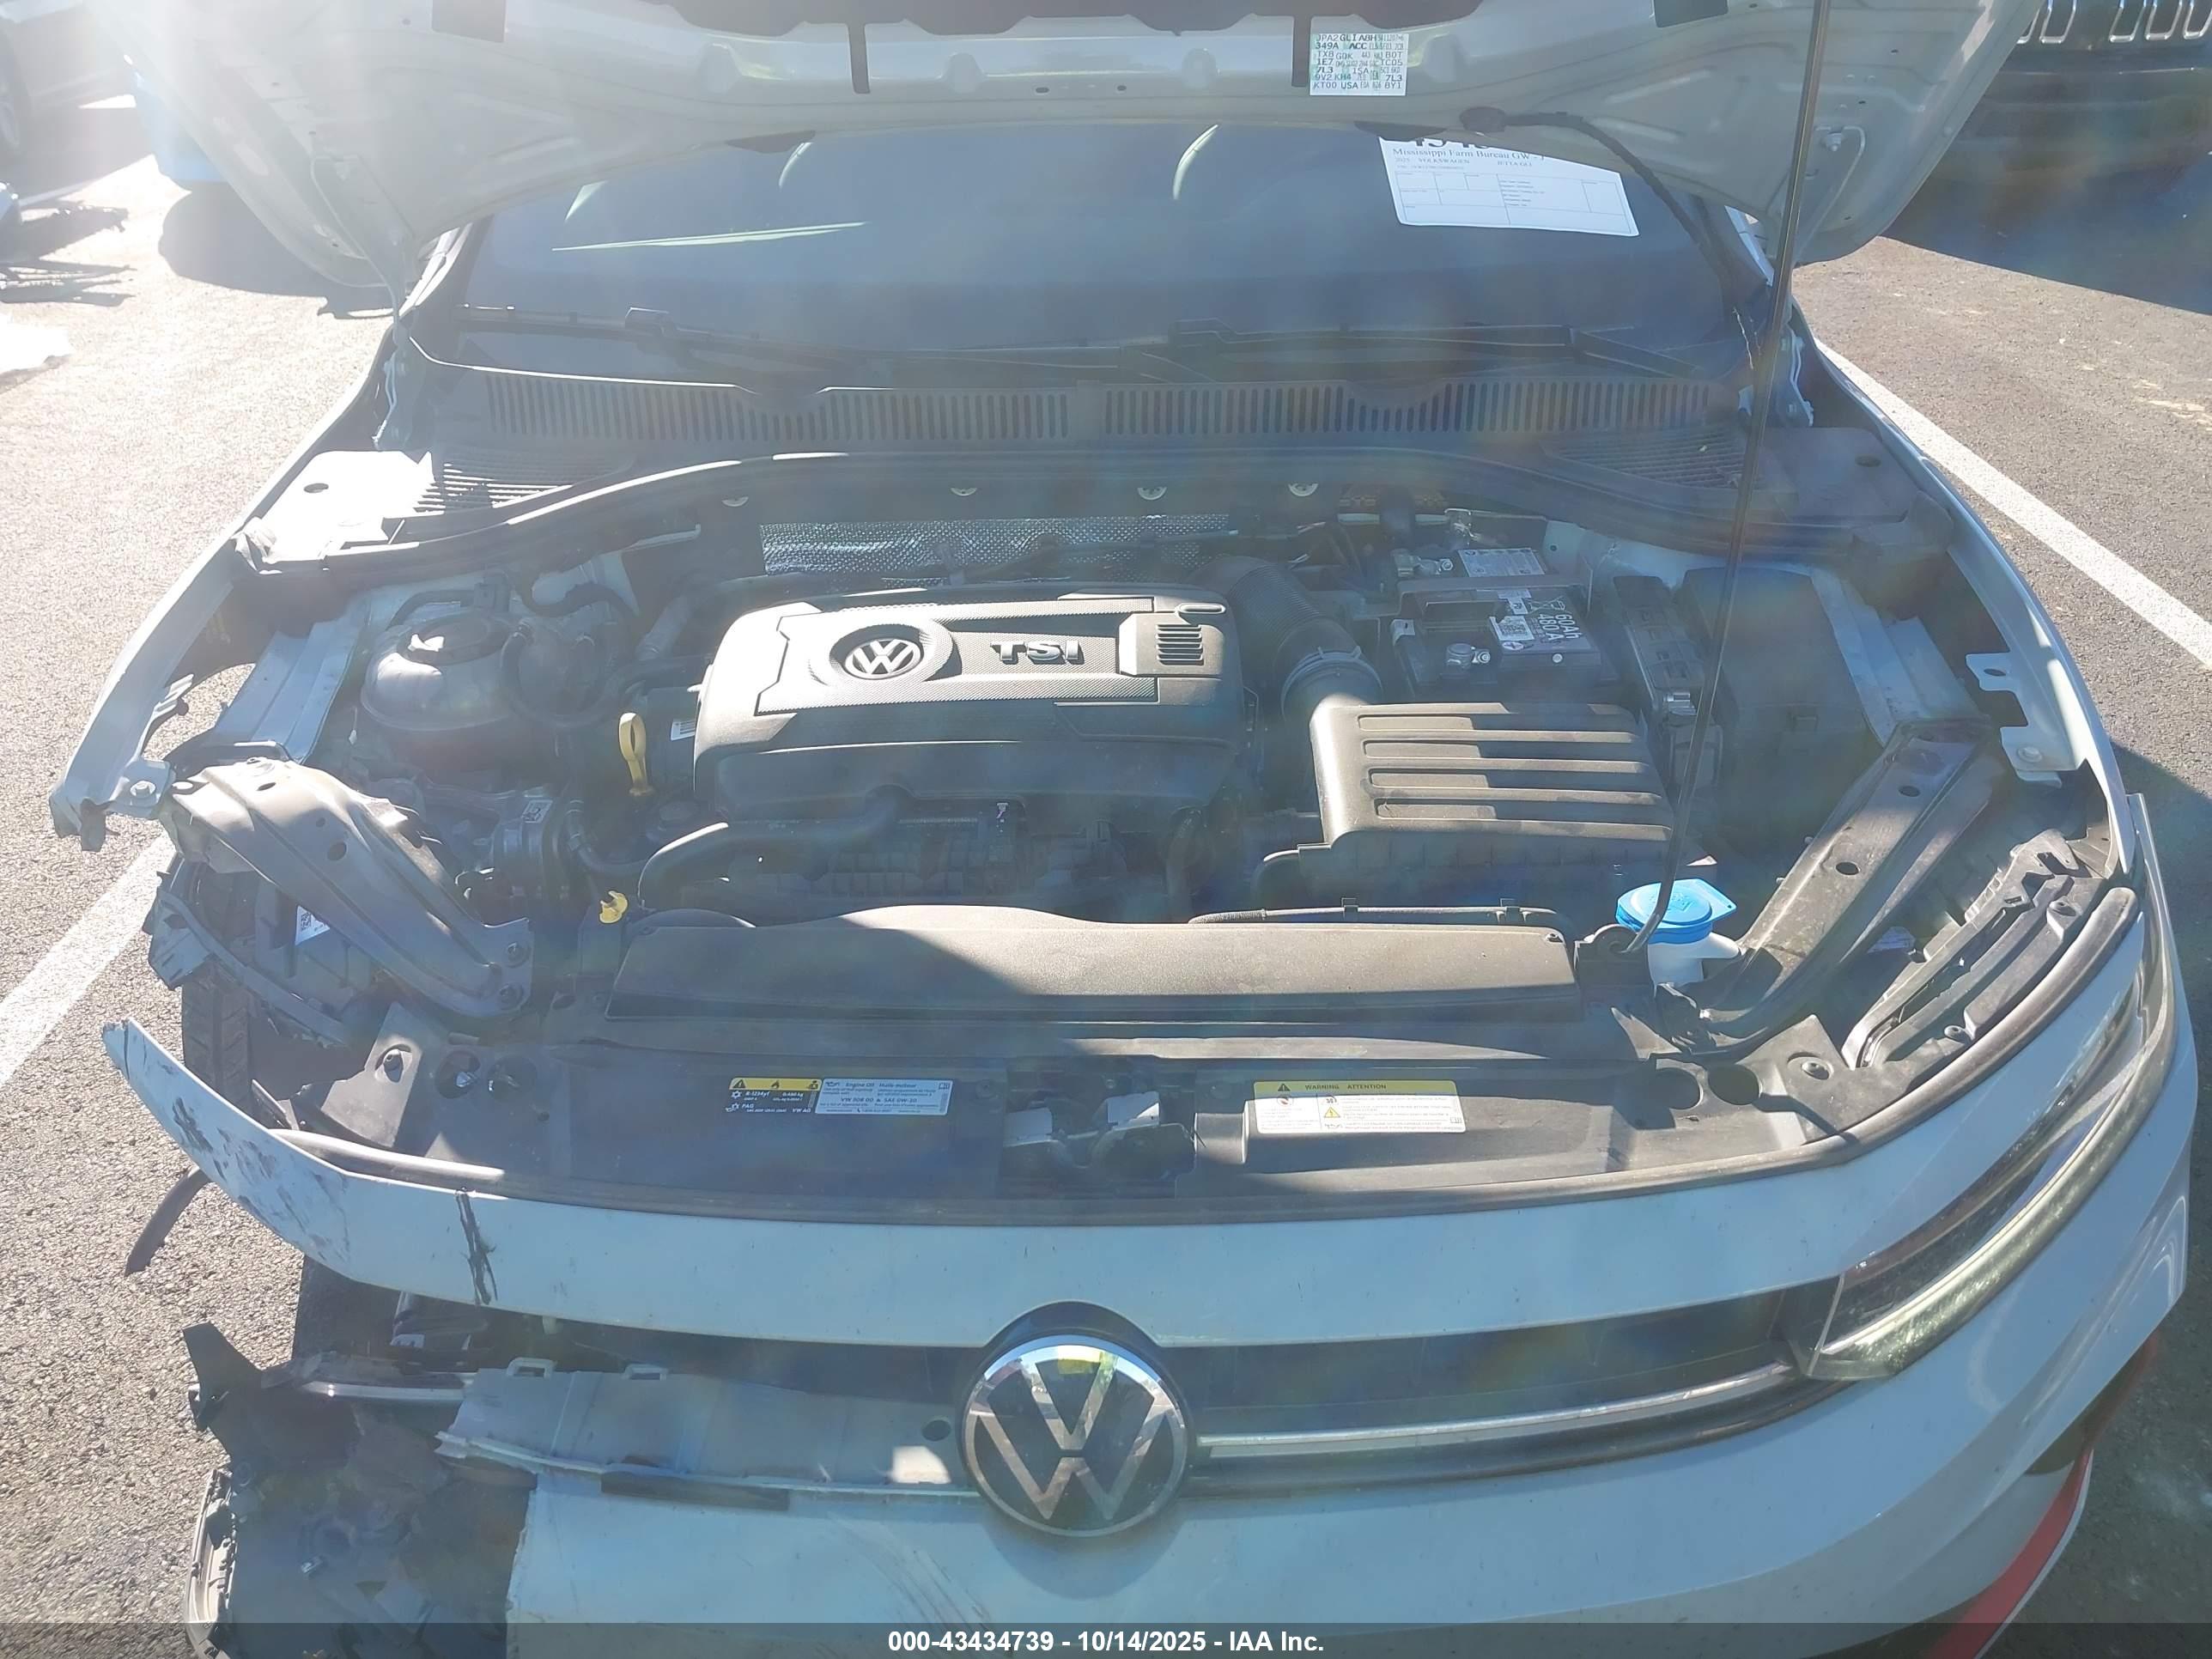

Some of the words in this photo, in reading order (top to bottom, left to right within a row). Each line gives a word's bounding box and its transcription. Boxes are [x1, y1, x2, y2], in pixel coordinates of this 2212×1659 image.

[1393, 148, 1446, 157] Mississippi
[1476, 150, 1510, 159] Bureau
[1538, 613, 1561, 631] 480
[1555, 614, 1583, 639] 60Ah
[990, 640, 1082, 662] TSI
[965, 1340, 1185, 1534] VW
